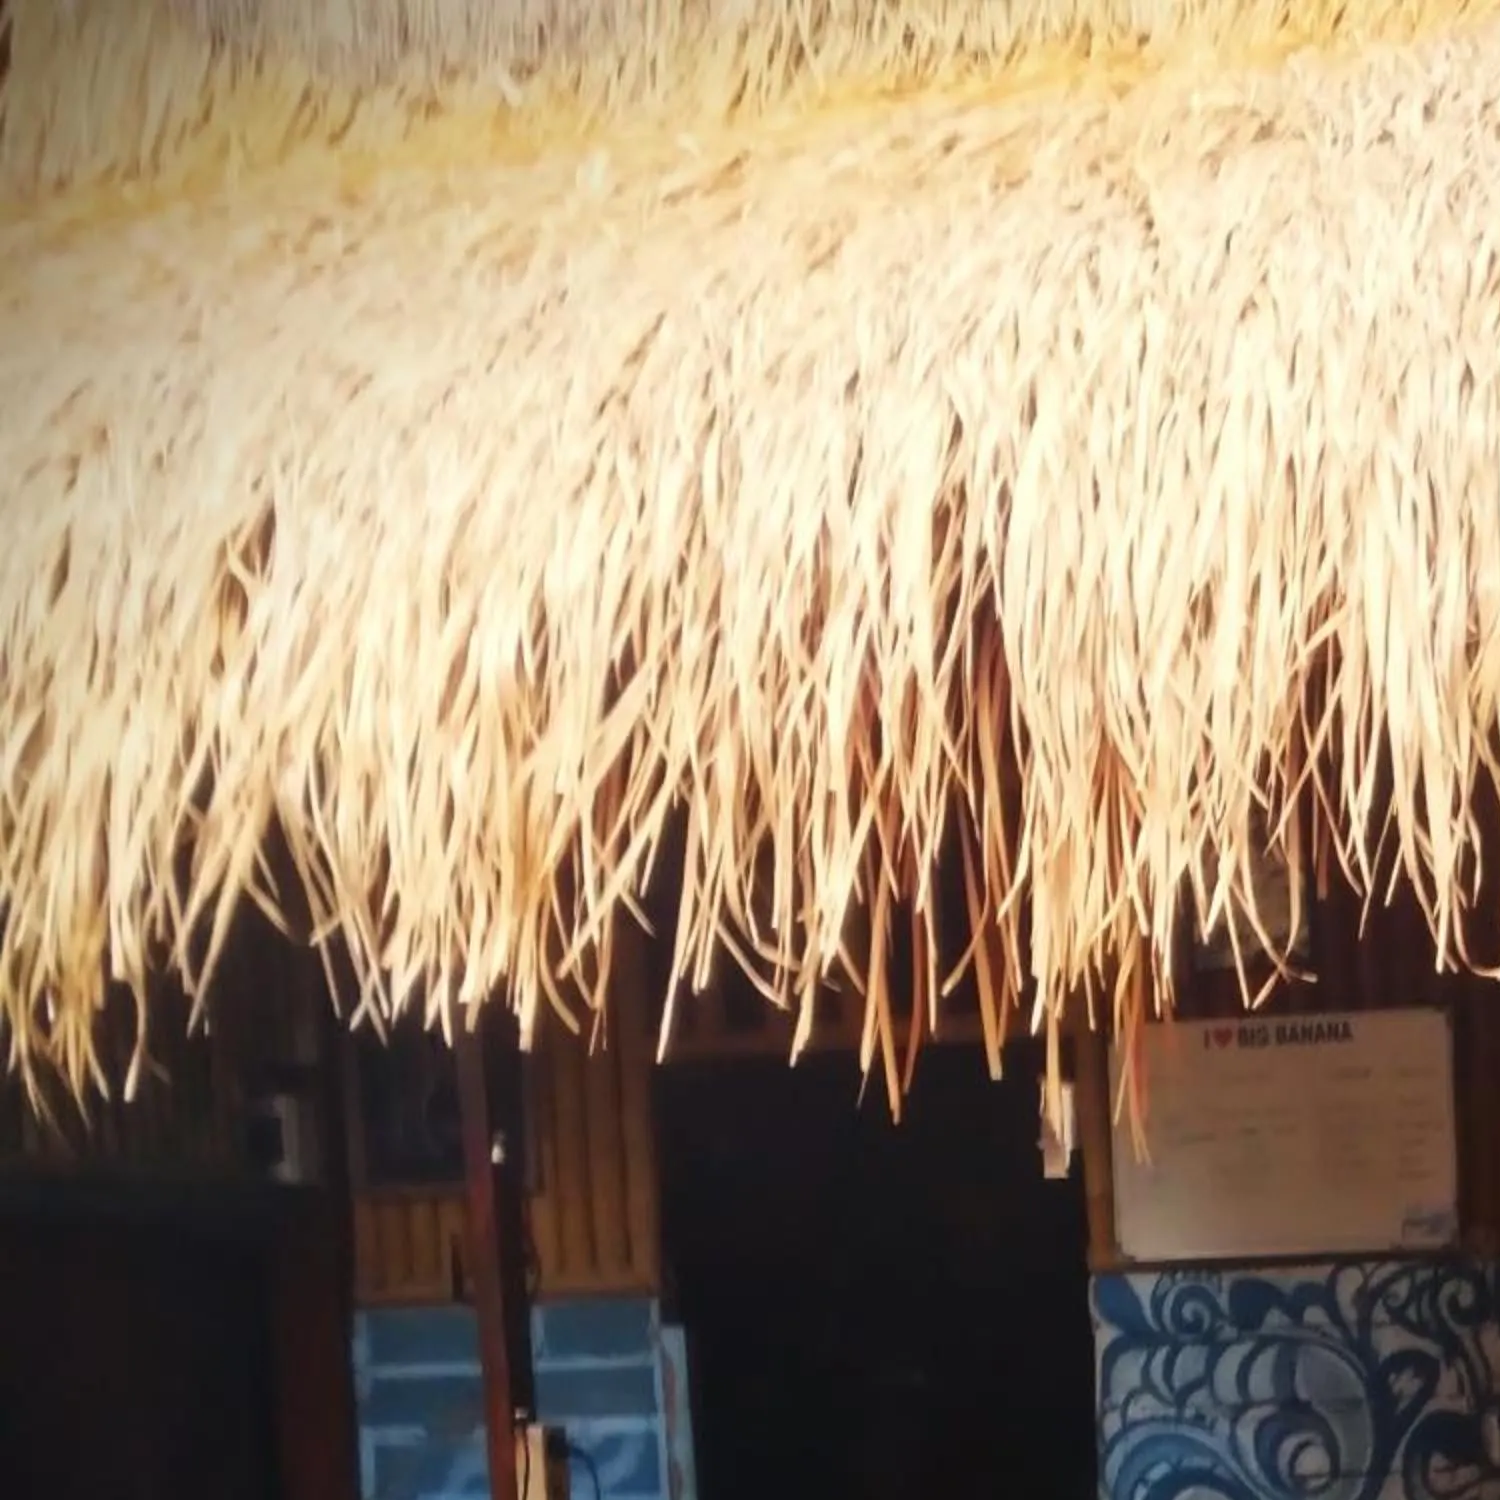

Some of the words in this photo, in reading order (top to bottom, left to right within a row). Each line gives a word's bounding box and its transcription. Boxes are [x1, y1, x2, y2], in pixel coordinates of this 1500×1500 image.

[1204, 1028, 1210, 1049] I
[1238, 1025, 1269, 1048] BIG
[1276, 1020, 1353, 1046] BANANA
